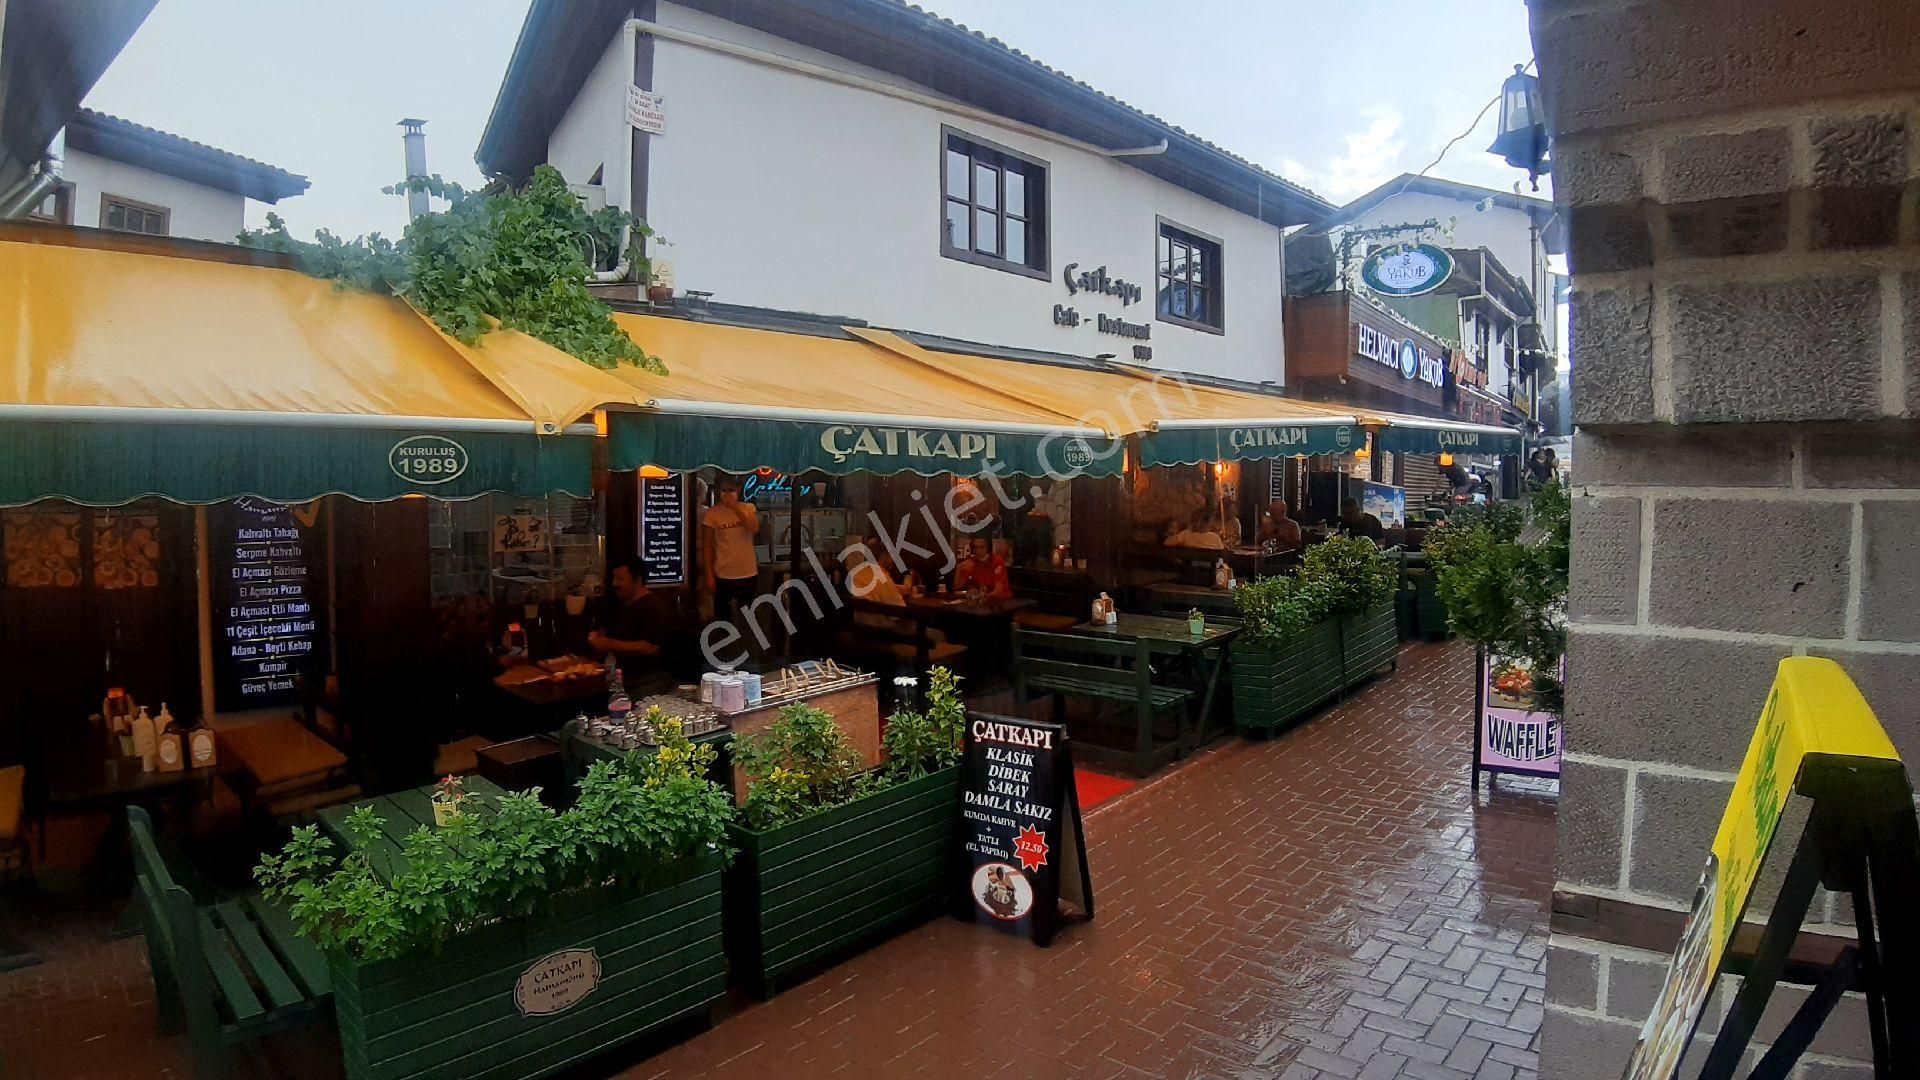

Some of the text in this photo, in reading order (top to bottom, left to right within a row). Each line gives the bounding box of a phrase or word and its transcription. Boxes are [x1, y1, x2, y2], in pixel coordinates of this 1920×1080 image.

[1387, 265, 1427, 280] YAKUB
[1063, 262, 1142, 307] Çatkapı
[1097, 312, 1152, 341] Restaurant
[1358, 322, 1400, 370] HELVACI
[1418, 347, 1444, 389] YAKUB
[819, 424, 998, 463] ÇATKAPI
[1229, 427, 1308, 454] ÇATKAPI
[1438, 430, 1479, 448] ÇATKAPI
[399, 447, 456, 457] KURULUŞ
[1066, 452, 1091, 462] 1989
[398, 457, 458, 474] 1989
[236, 547, 268, 560] Serpme
[242, 567, 273, 580] Açması
[280, 584, 302, 596] Pizza
[240, 605, 271, 619] Açması
[231, 645, 258, 658] Adana
[972, 720, 1054, 750] ÇATKAPI
[1486, 711, 1558, 762] WAFFLE
[985, 747, 1036, 768] KLASİK
[987, 763, 1032, 785] DİBEK
[987, 779, 1030, 799] SARAY
[964, 790, 1054, 822] DAMLA SAKIZ
[963, 809, 1018, 830] KUMDA KAHVE
[976, 833, 1000, 847] TATLI
[1020, 839, 1044, 855] 12.50
[534, 958, 583, 984] ÇATKAPI
